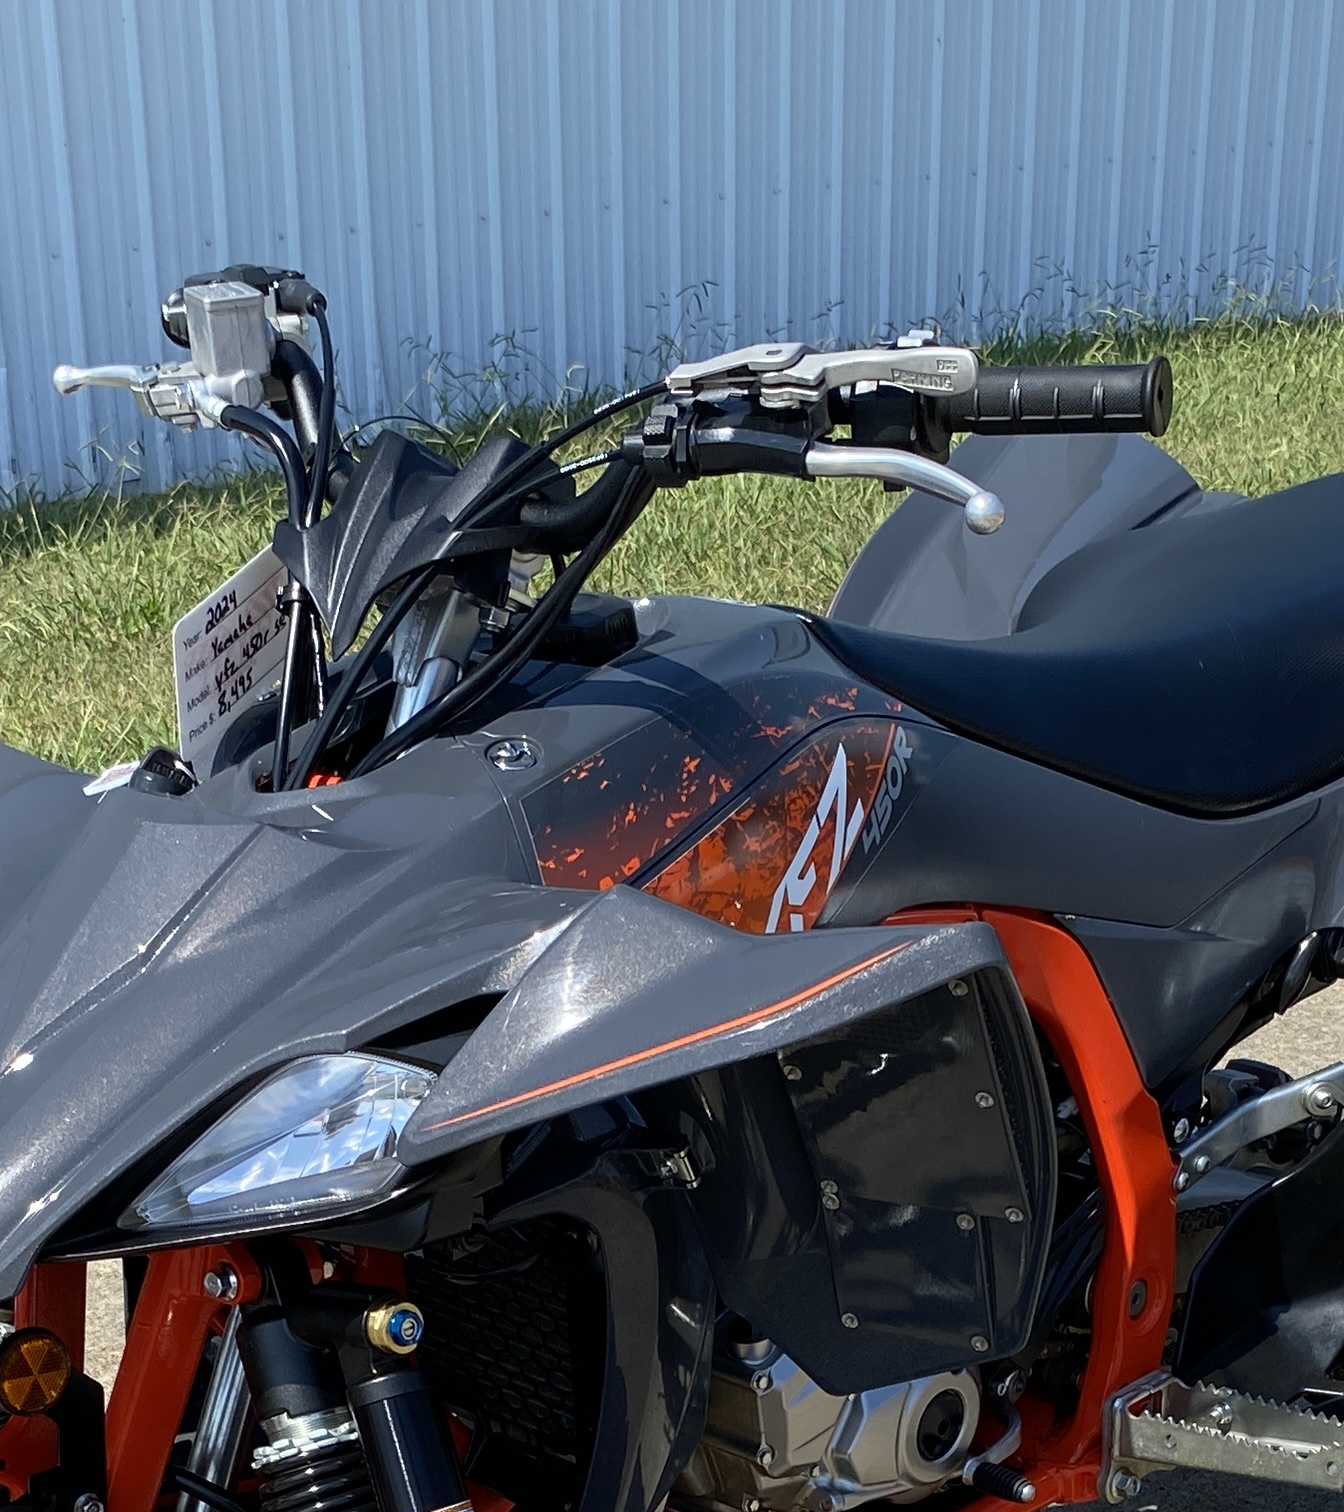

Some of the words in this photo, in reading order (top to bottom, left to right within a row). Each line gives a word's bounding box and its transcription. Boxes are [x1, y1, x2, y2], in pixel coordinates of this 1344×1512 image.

[891, 368, 954, 391] PARKING
[205, 589, 238, 635] 2024
[218, 667, 253, 717] 8,495
[861, 725, 913, 855] 450R
